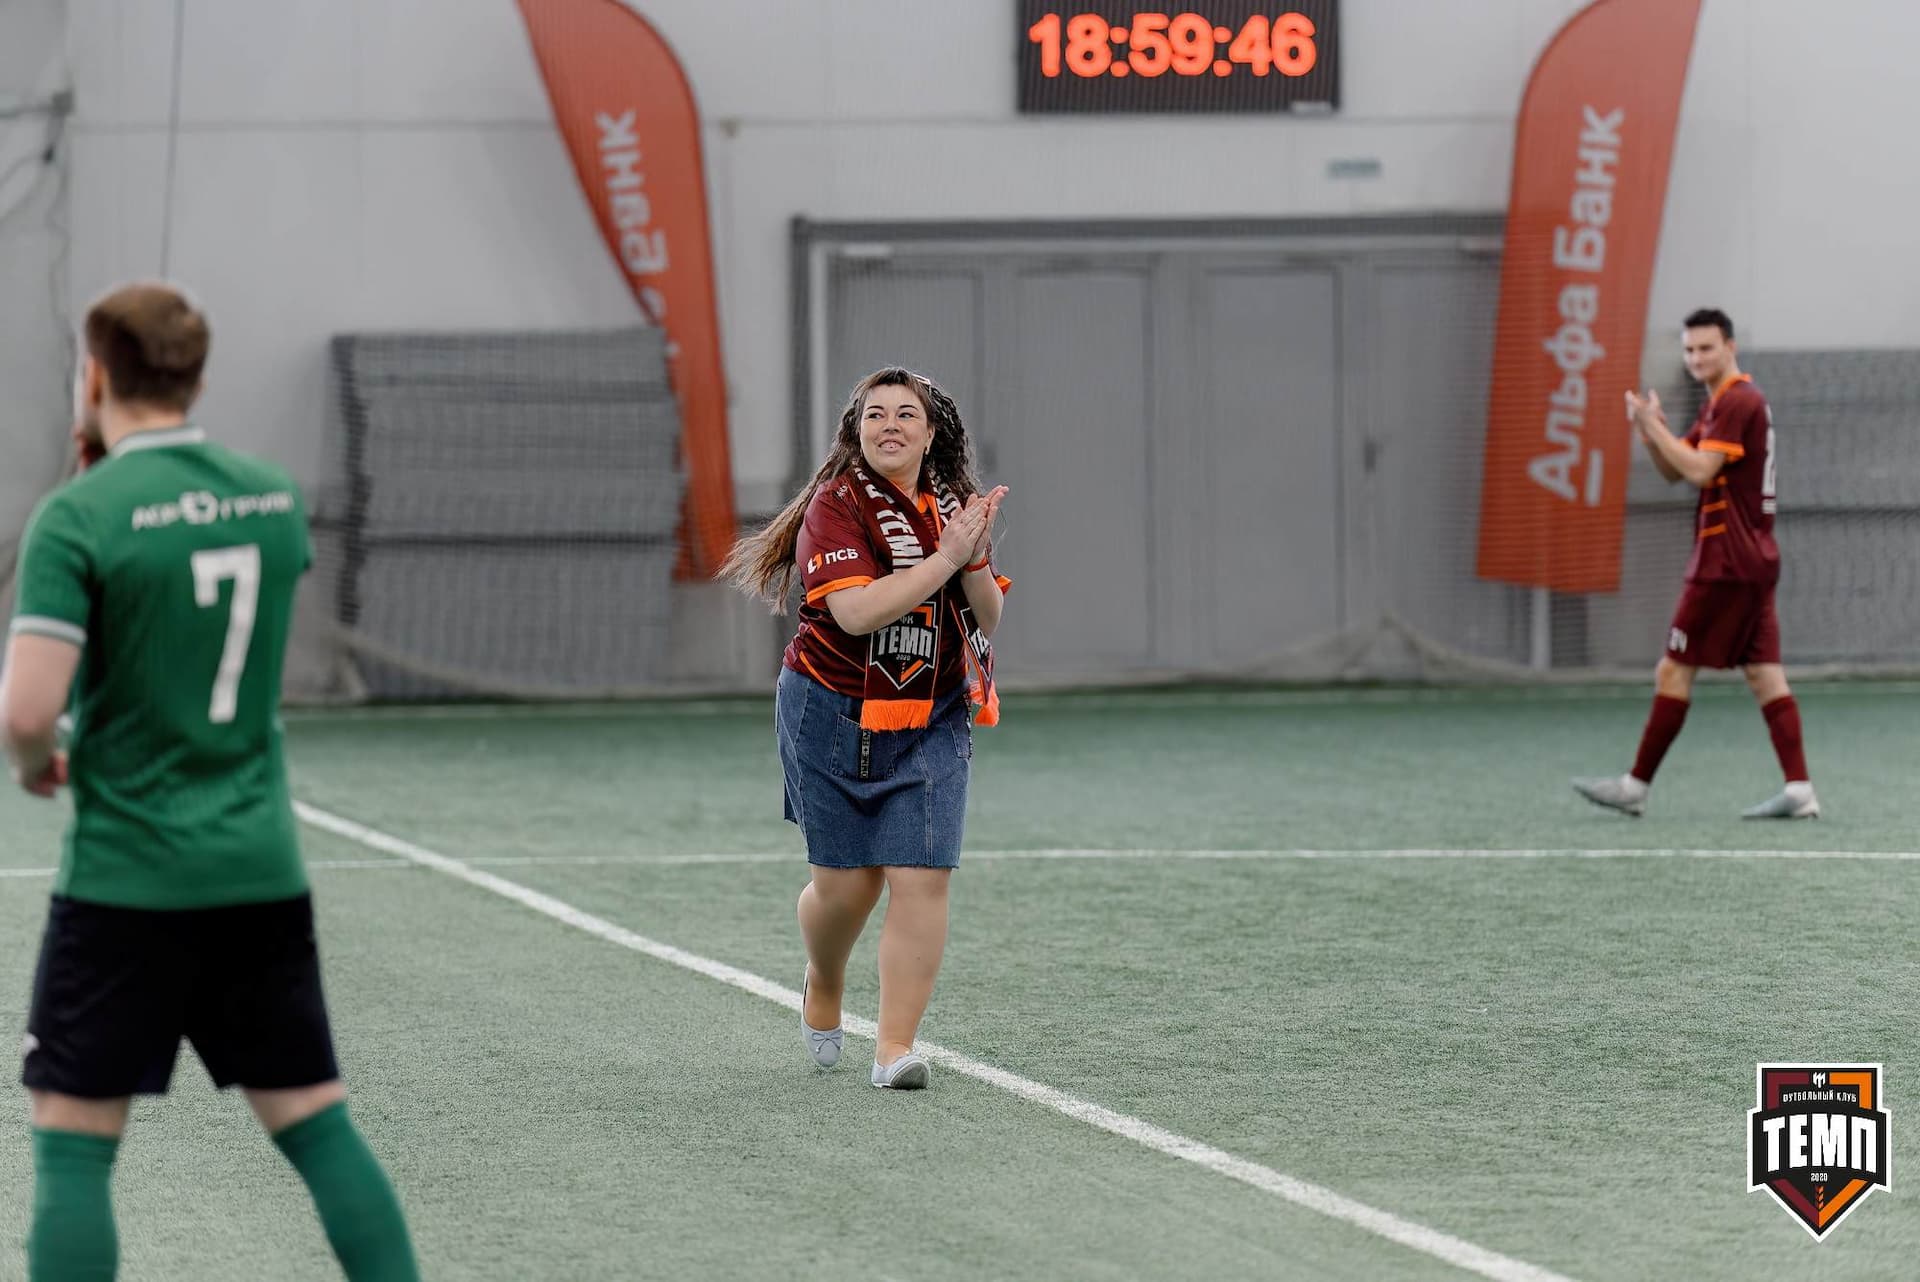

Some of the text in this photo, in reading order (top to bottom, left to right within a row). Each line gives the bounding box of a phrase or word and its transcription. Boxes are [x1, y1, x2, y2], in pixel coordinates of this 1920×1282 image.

[1028, 12, 1316, 77] 18:59:46
[1527, 103, 1625, 500] Альфа Банк
[825, 548, 859, 565] ПСБ
[190, 542, 262, 725] 7
[877, 625, 933, 659] ТЕМП
